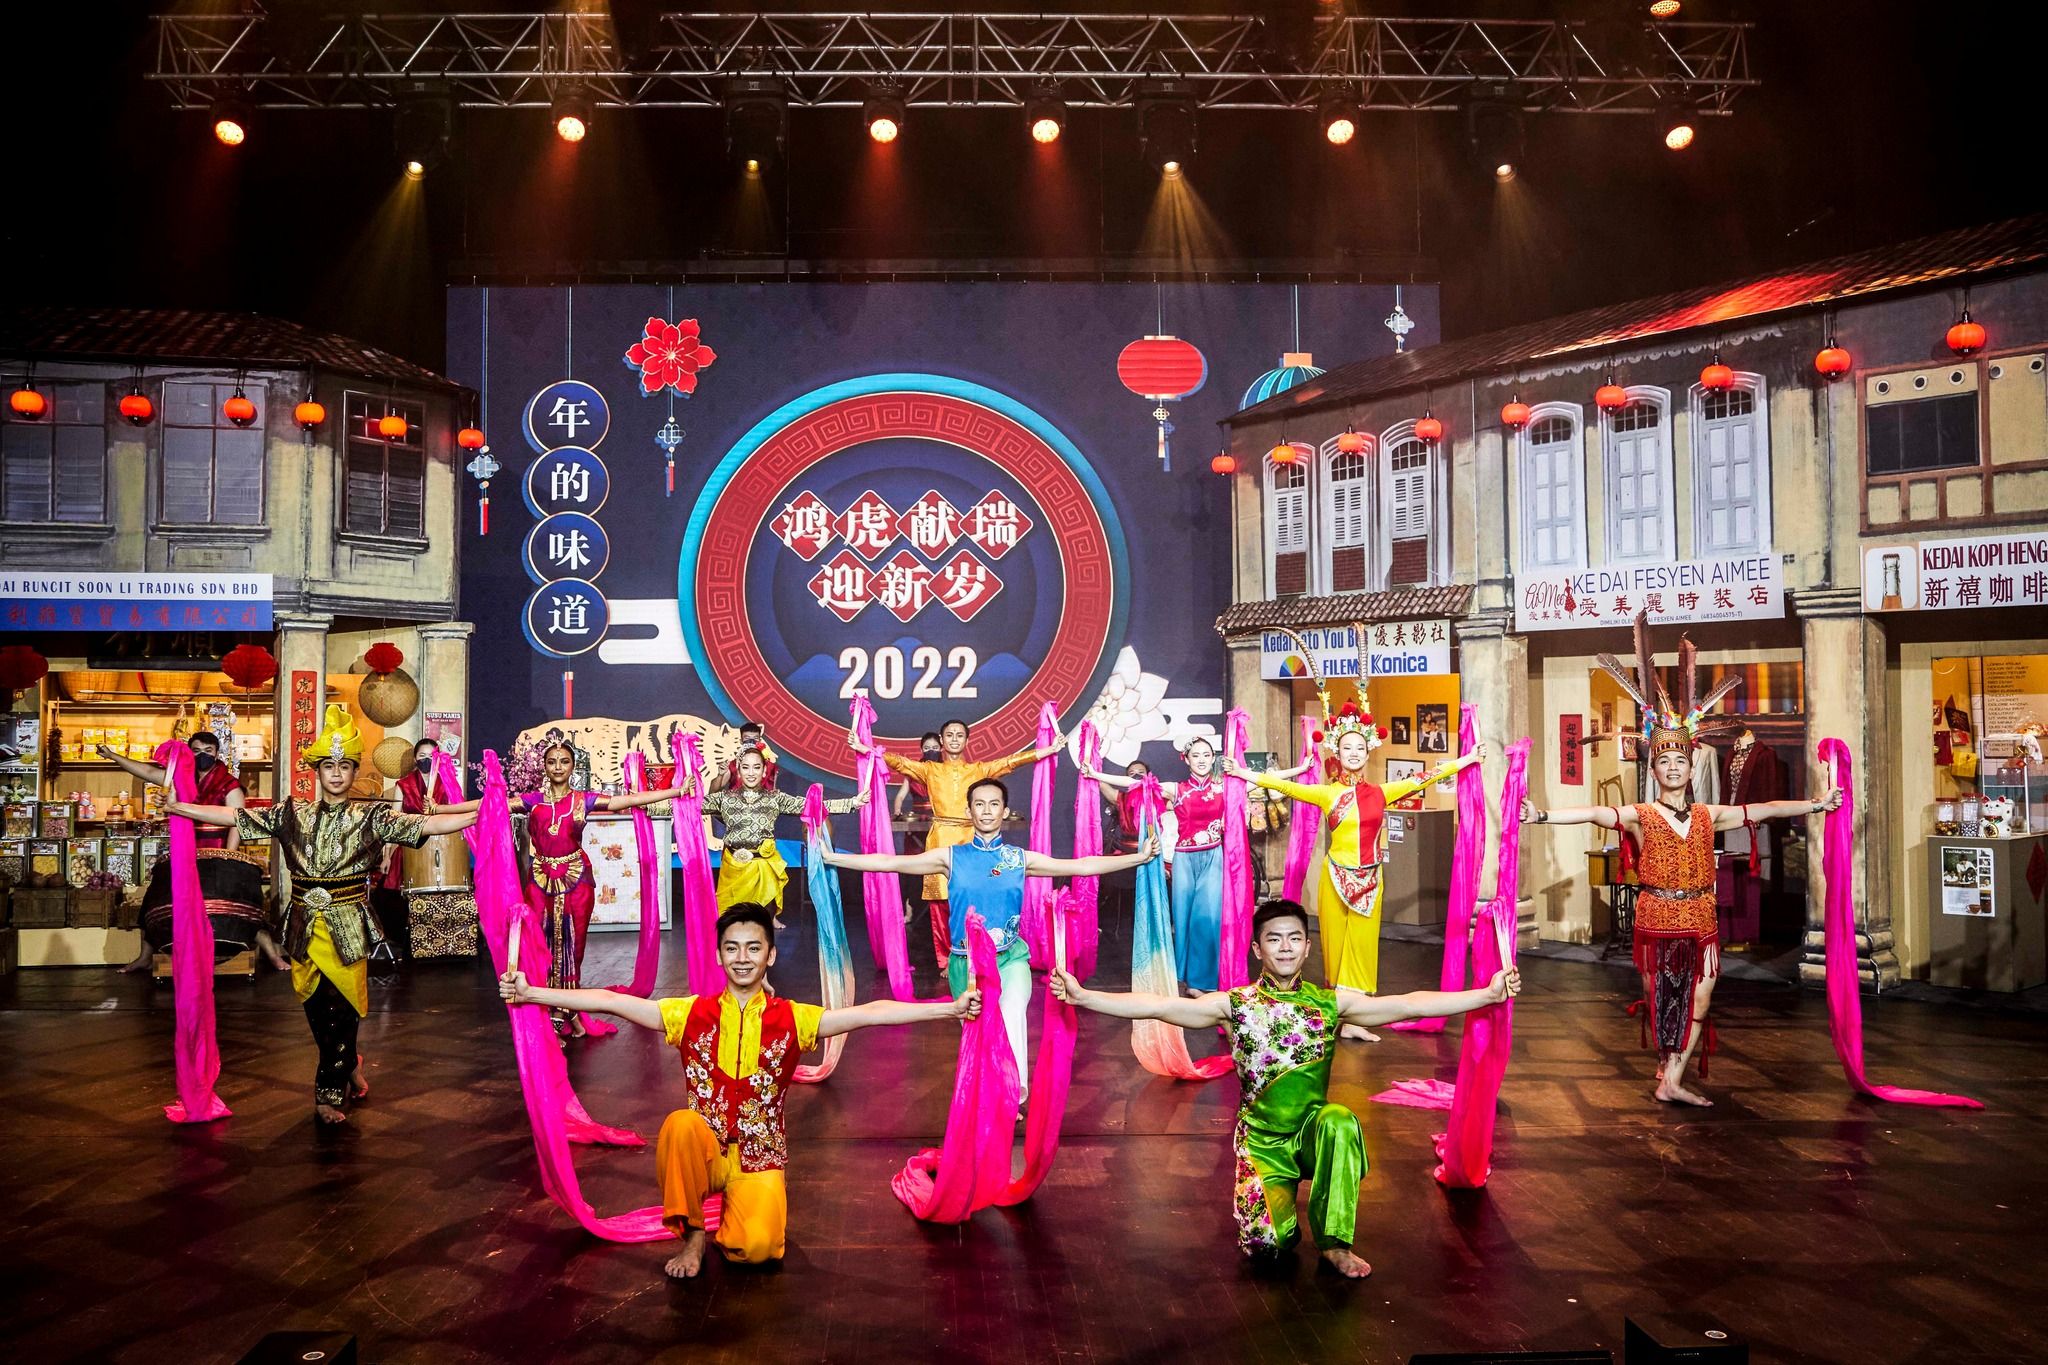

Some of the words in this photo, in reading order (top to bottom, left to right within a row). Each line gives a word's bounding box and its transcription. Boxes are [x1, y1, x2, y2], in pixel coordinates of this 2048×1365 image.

[548, 397, 591, 635] 年的味道
[781, 500, 1020, 548] 鸿虎献瑞
[1923, 546, 1965, 571] KEDAI
[1968, 543, 2004, 568] KOPI
[2007, 539, 2048, 565] HENG
[0, 581, 15, 592] AI
[23, 581, 71, 593] RUNCIT
[79, 581, 113, 593] SOON
[120, 582, 131, 593] LI
[139, 583, 195, 594] TRADING
[201, 583, 225, 594] SDN
[233, 583, 258, 594] BHD
[817, 562, 986, 610] 迎新岁
[1635, 564, 1705, 590] FESYEN
[1711, 558, 1770, 584] AIMEE
[1924, 570, 2048, 608] 新禧咖啡
[1580, 584, 1768, 617] 愛美麗時裝店
[1263, 630, 1292, 652] Kedai
[1323, 628, 1344, 649] You
[1374, 623, 1446, 648] 優美影社
[839, 646, 978, 699] 2022
[1323, 659, 1359, 675] FILEM
[1371, 652, 1428, 674] Konica
[295, 678, 315, 804] 虎躍龍騰生紫
